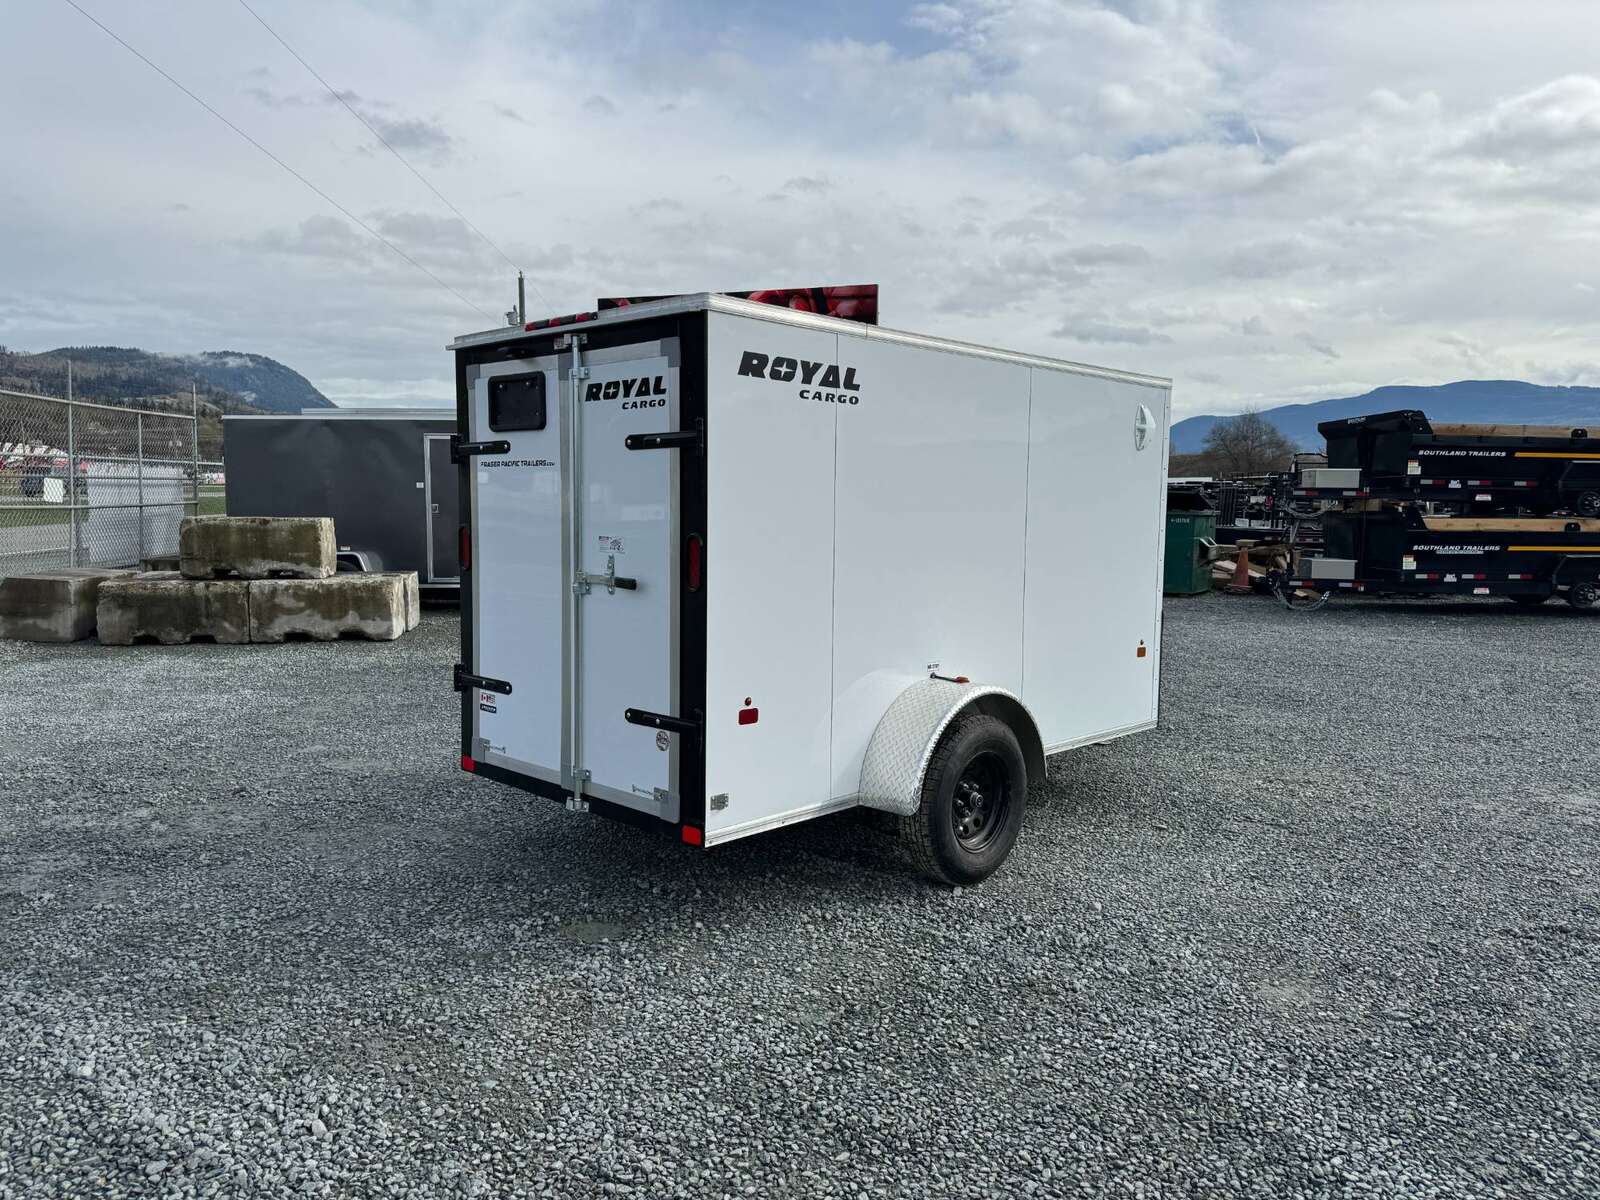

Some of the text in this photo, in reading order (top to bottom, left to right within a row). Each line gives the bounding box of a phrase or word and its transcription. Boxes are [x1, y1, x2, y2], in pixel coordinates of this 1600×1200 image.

[737, 350, 860, 391] ROYAL
[585, 375, 667, 402] ROYAL
[799, 389, 860, 405] CARGO
[621, 398, 666, 410] CARGO
